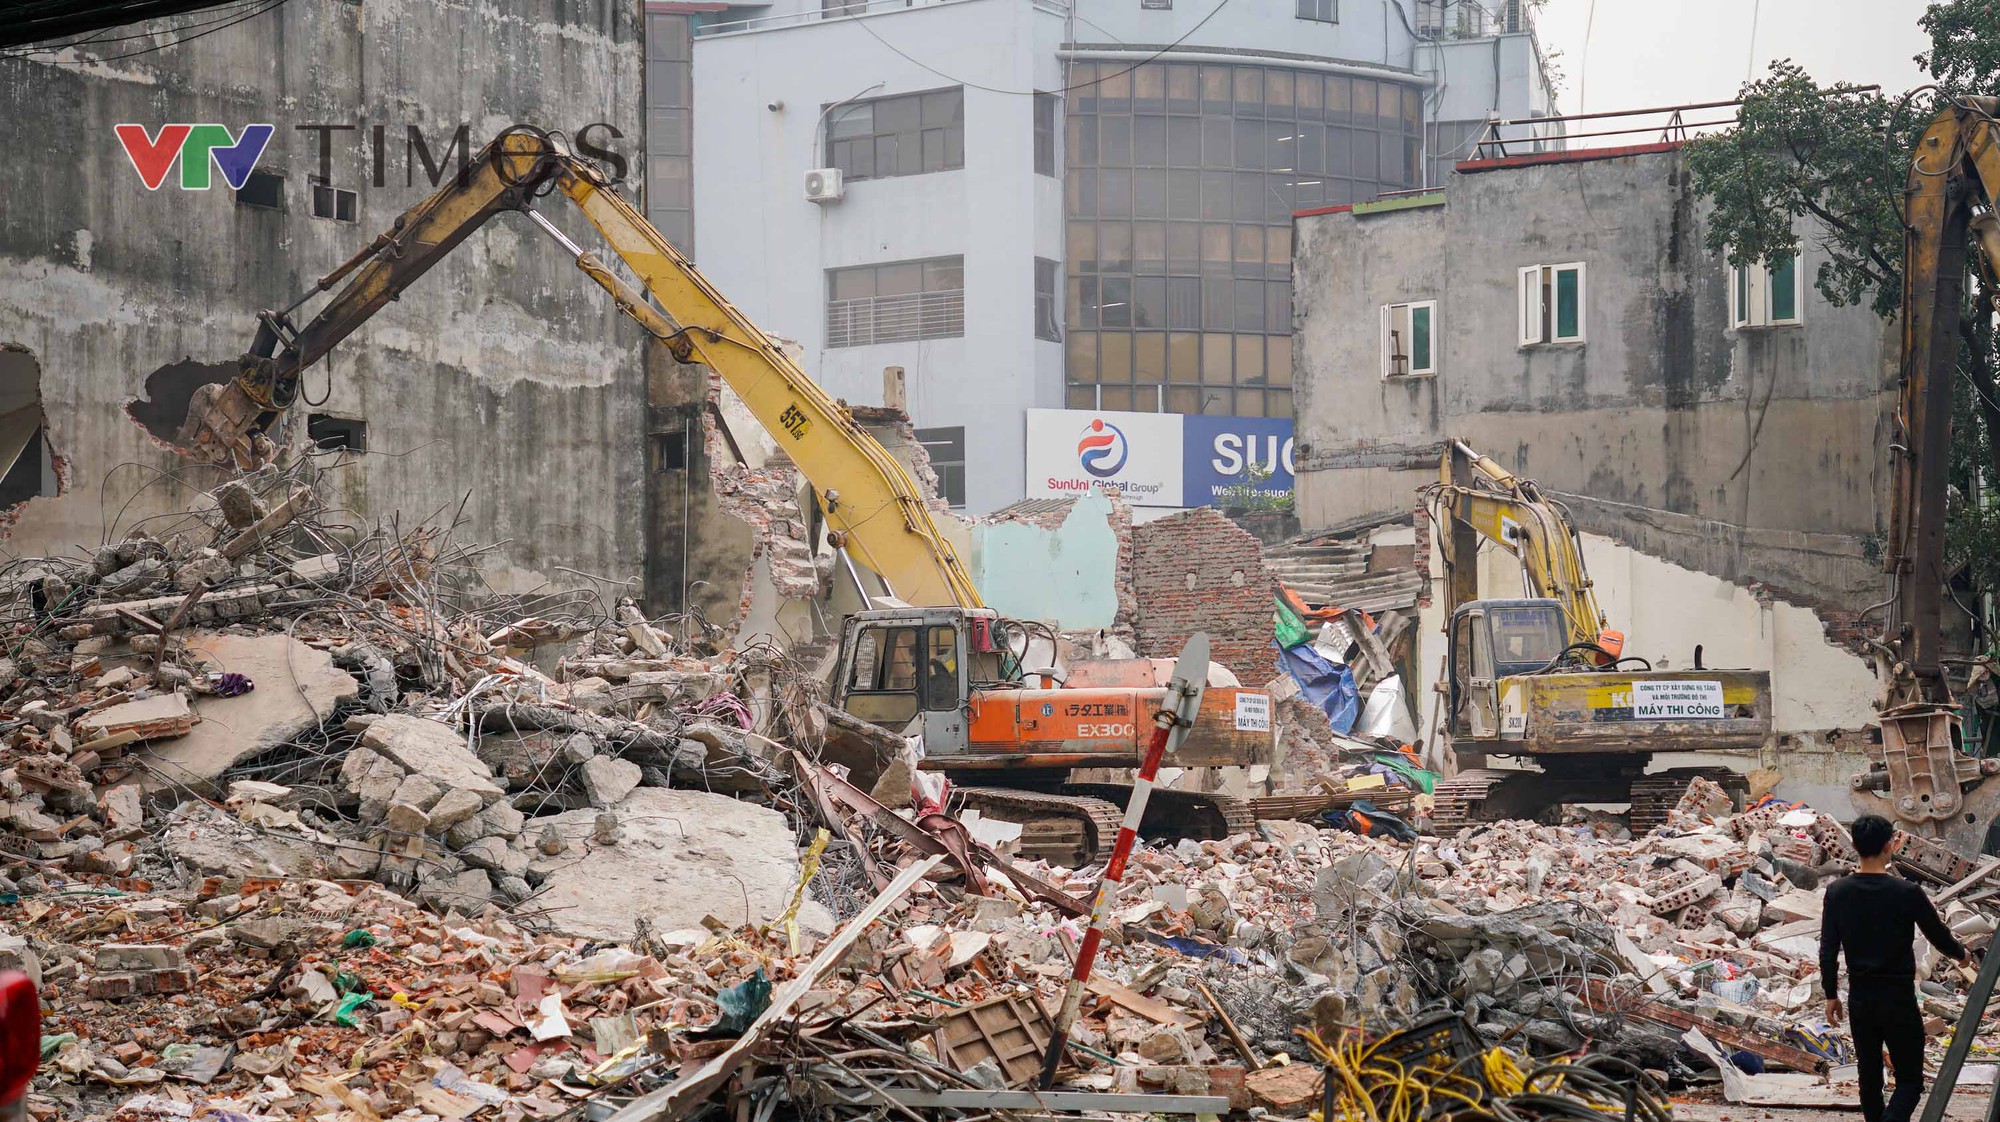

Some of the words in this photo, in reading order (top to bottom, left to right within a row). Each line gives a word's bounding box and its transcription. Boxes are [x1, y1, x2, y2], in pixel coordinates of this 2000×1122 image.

[1047, 478, 1089, 490] SunUni
[1639, 703, 1664, 715] MÁY
[1667, 706, 1684, 715] THI
[1687, 703, 1720, 715] CÔNG
[1077, 723, 1135, 737] EX300
